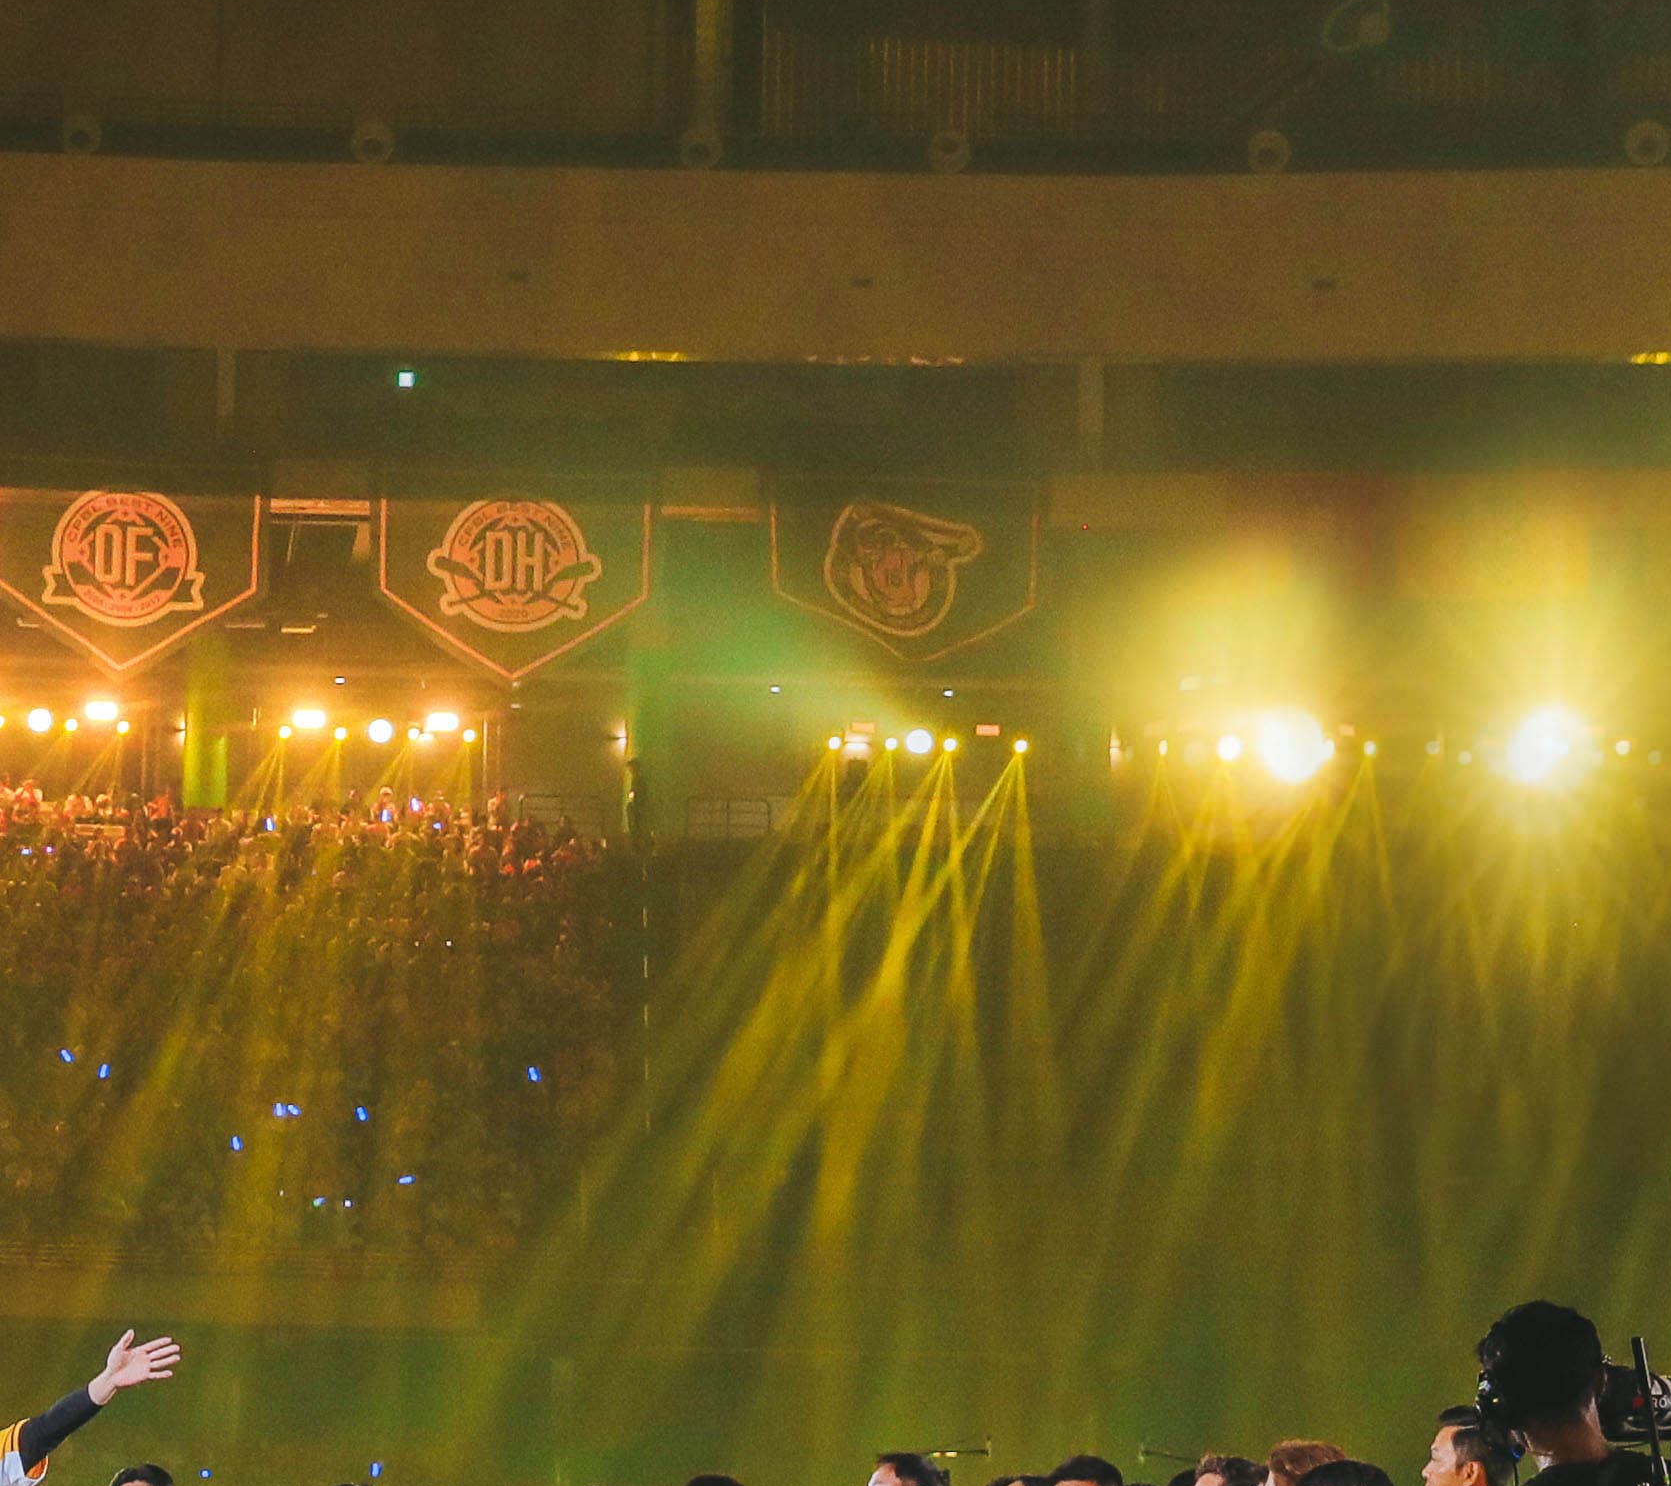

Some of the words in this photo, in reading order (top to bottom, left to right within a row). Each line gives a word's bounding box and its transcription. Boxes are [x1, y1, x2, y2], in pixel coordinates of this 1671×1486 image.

[94, 523, 154, 586] OF
[158, 510, 184, 548] NINE
[484, 529, 545, 593] DH
